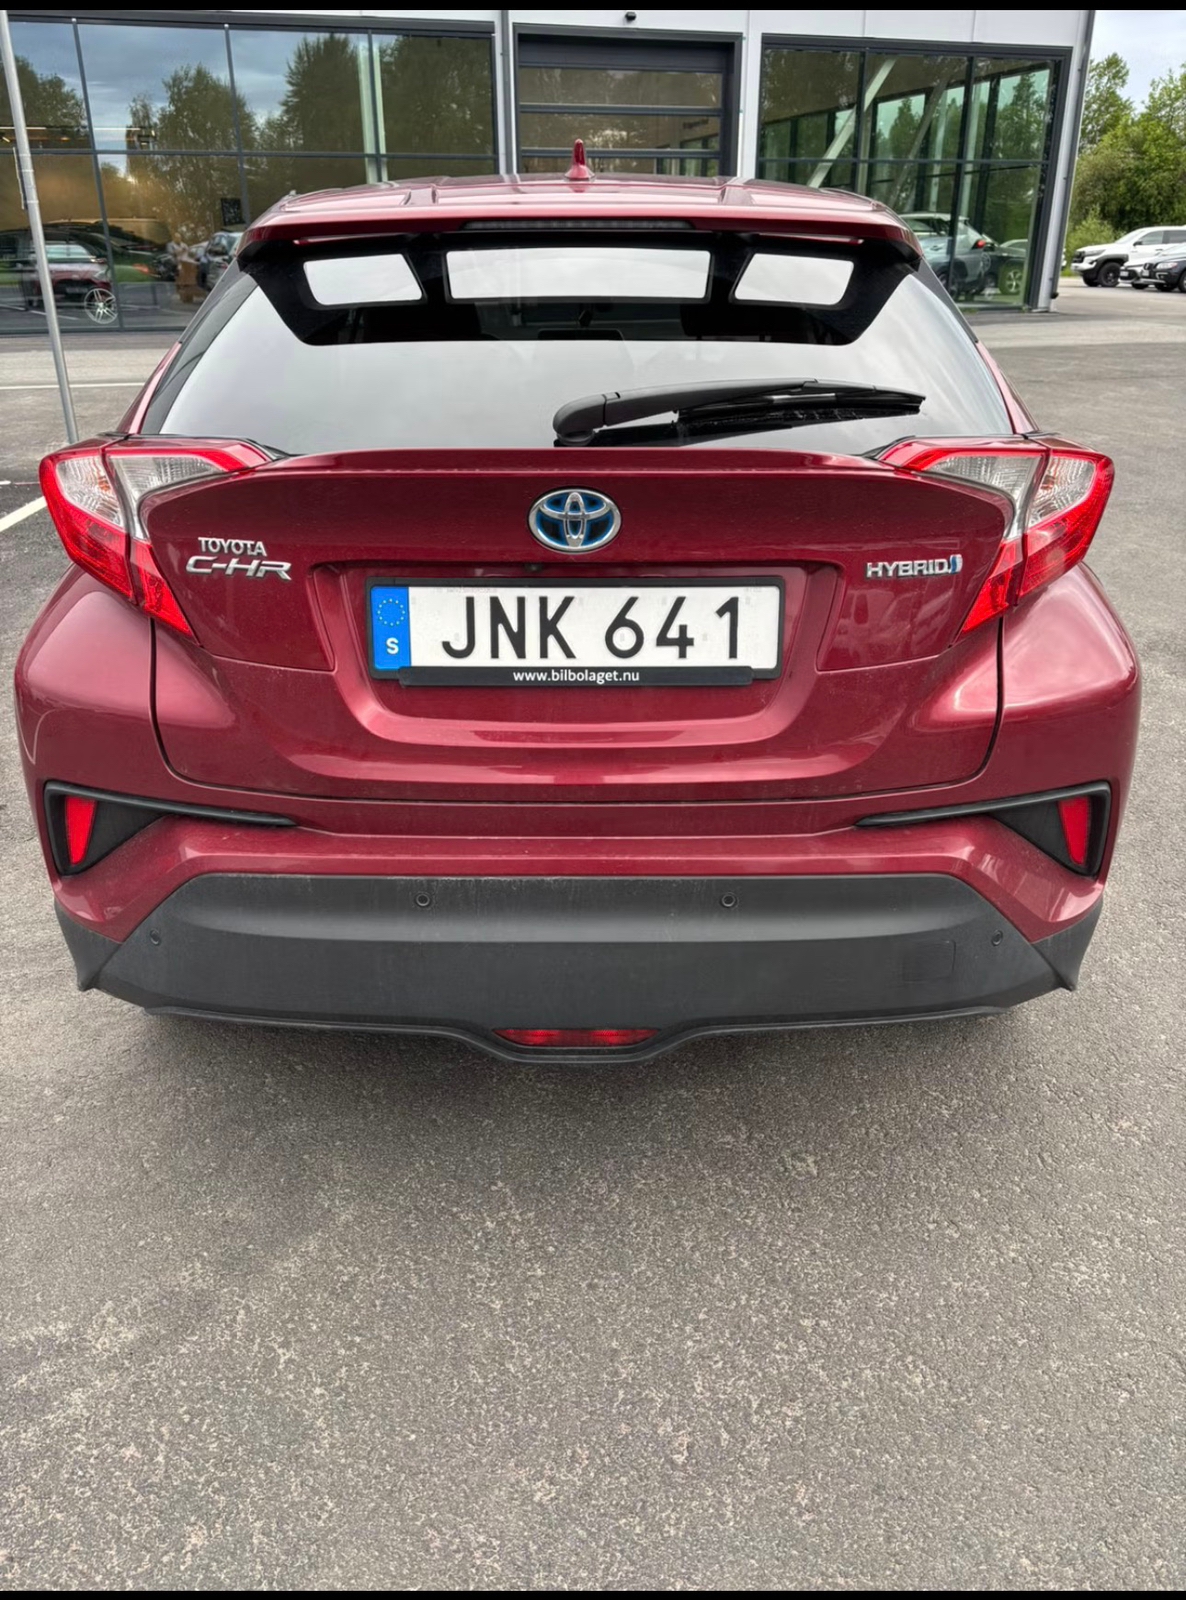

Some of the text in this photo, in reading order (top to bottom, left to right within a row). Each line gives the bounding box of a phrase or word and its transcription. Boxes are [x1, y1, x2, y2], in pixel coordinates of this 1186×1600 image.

[198, 537, 267, 557] TOYOTA
[186, 556, 292, 580] C-HR
[866, 559, 949, 578] HYBRID
[442, 596, 739, 659] JNK 641
[386, 637, 399, 655] S
[513, 669, 640, 685] www.bilbolaget.nu
